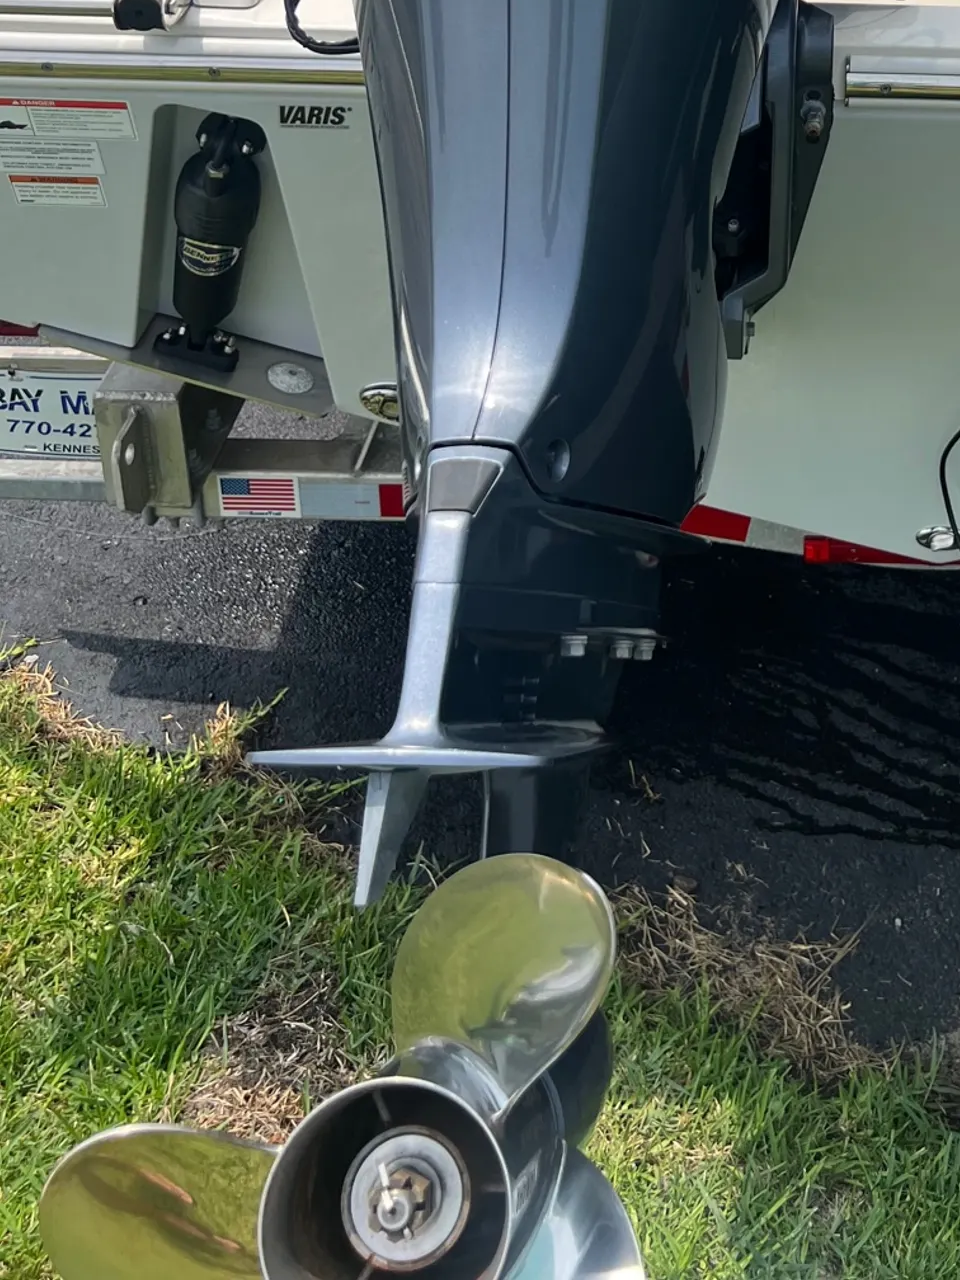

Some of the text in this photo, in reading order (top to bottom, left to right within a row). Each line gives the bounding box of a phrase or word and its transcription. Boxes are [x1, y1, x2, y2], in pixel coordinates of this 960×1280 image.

[279, 105, 347, 126] VARIS
[59, 390, 95, 416] M
[6, 418, 97, 438] 770-42
